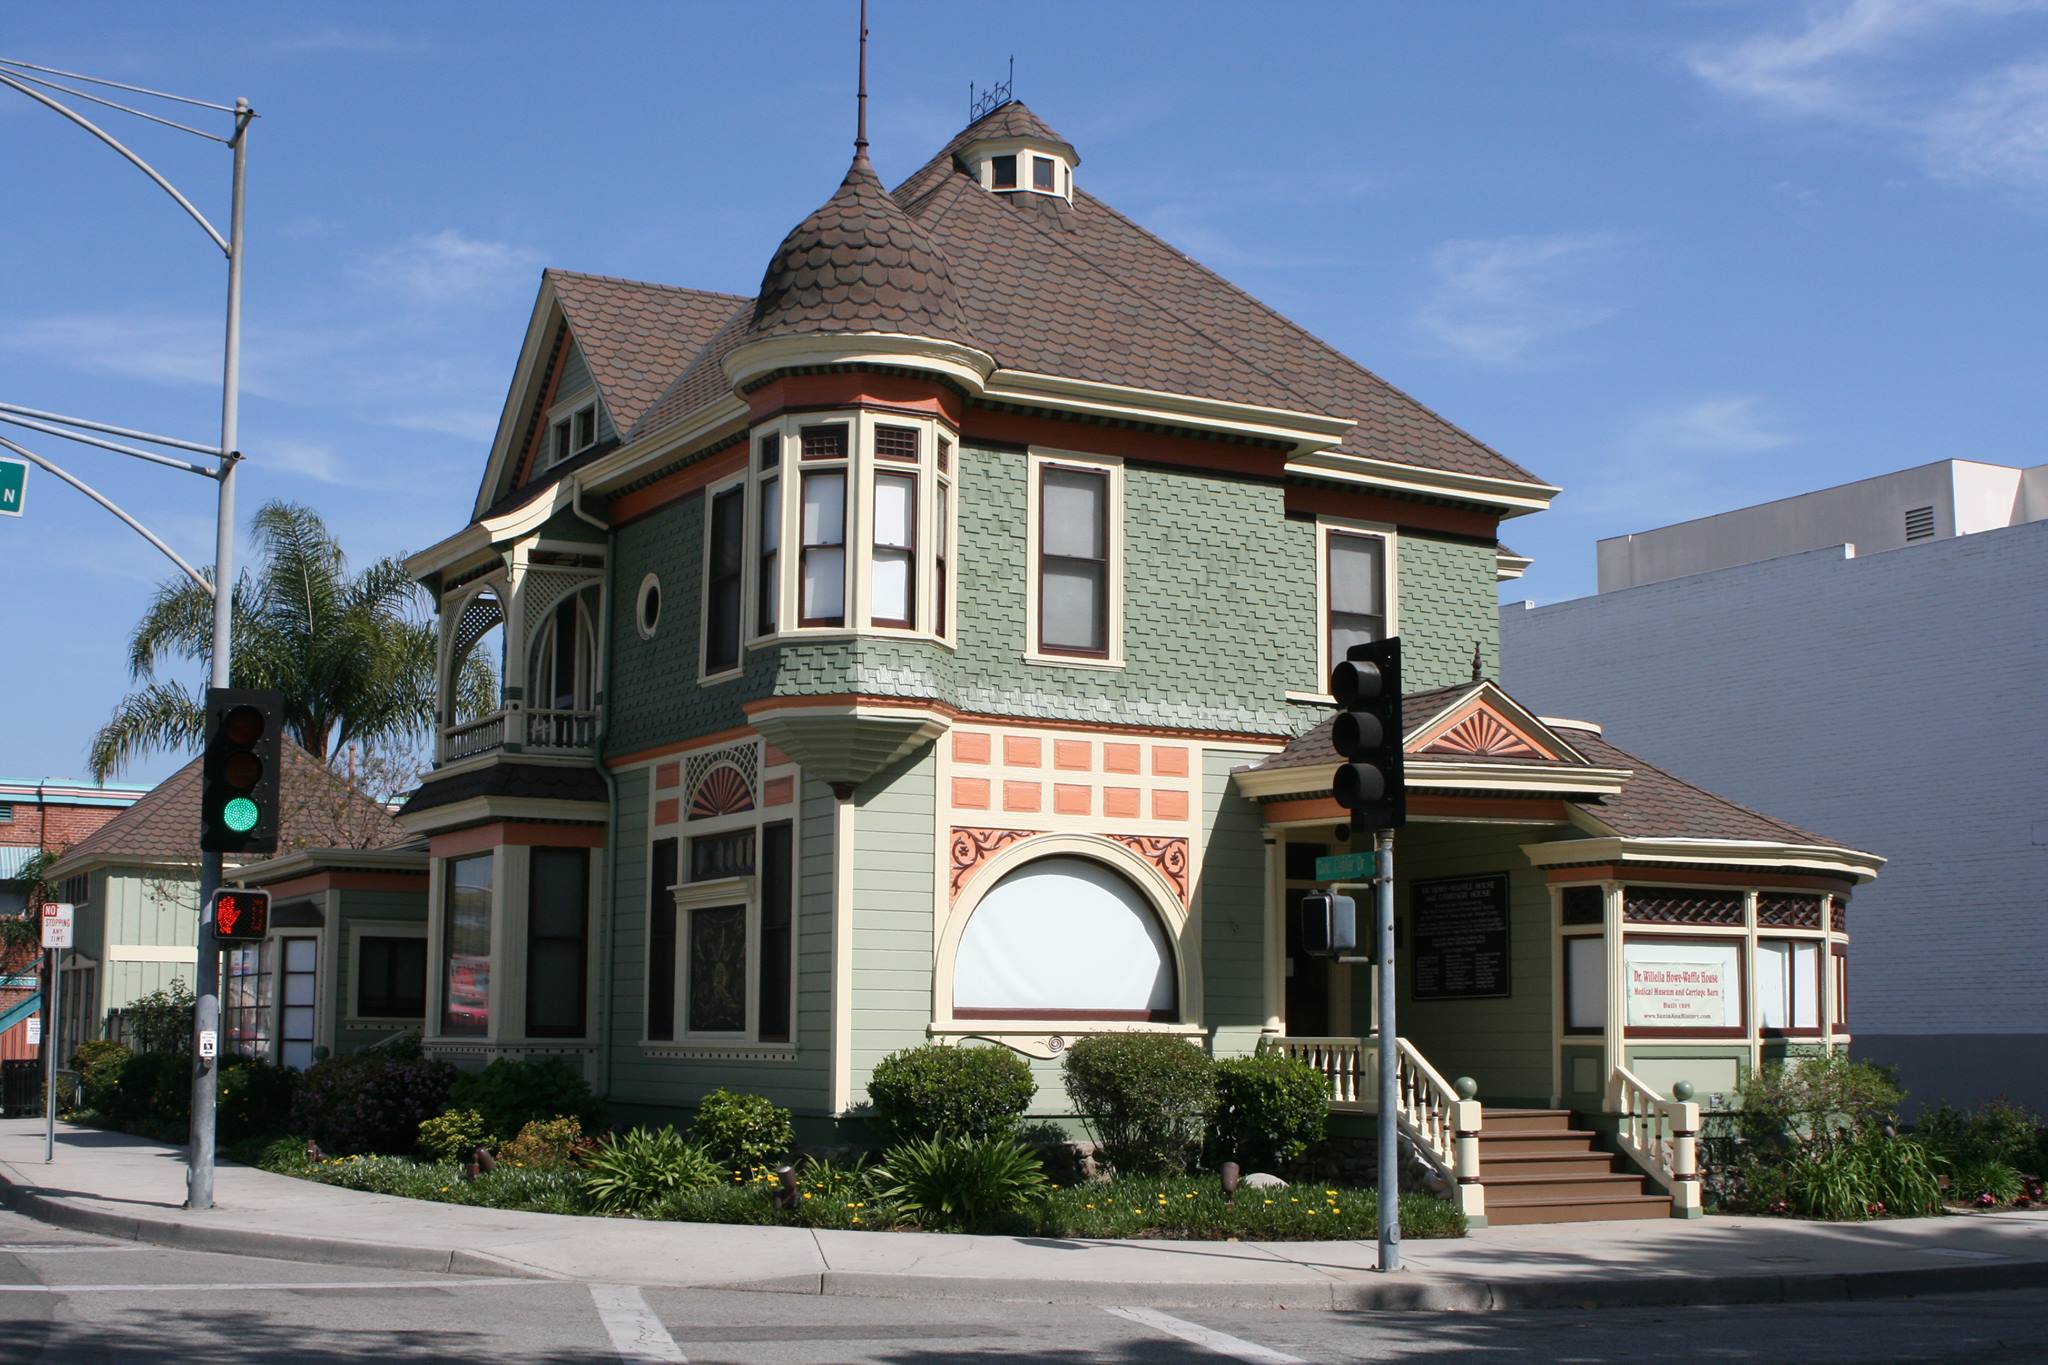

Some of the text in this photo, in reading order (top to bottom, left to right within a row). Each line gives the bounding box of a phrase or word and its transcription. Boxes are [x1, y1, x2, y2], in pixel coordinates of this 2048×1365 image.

[3, 488, 16, 503] N
[45, 905, 56, 916] NO
[1634, 970, 1718, 983] Dr. Willella Howe-Waffle House
[1634, 987, 1653, 996] Medical
[1654, 987, 1674, 996] Museum
[1675, 988, 1684, 996] and
[1707, 988, 1718, 996] Barn
